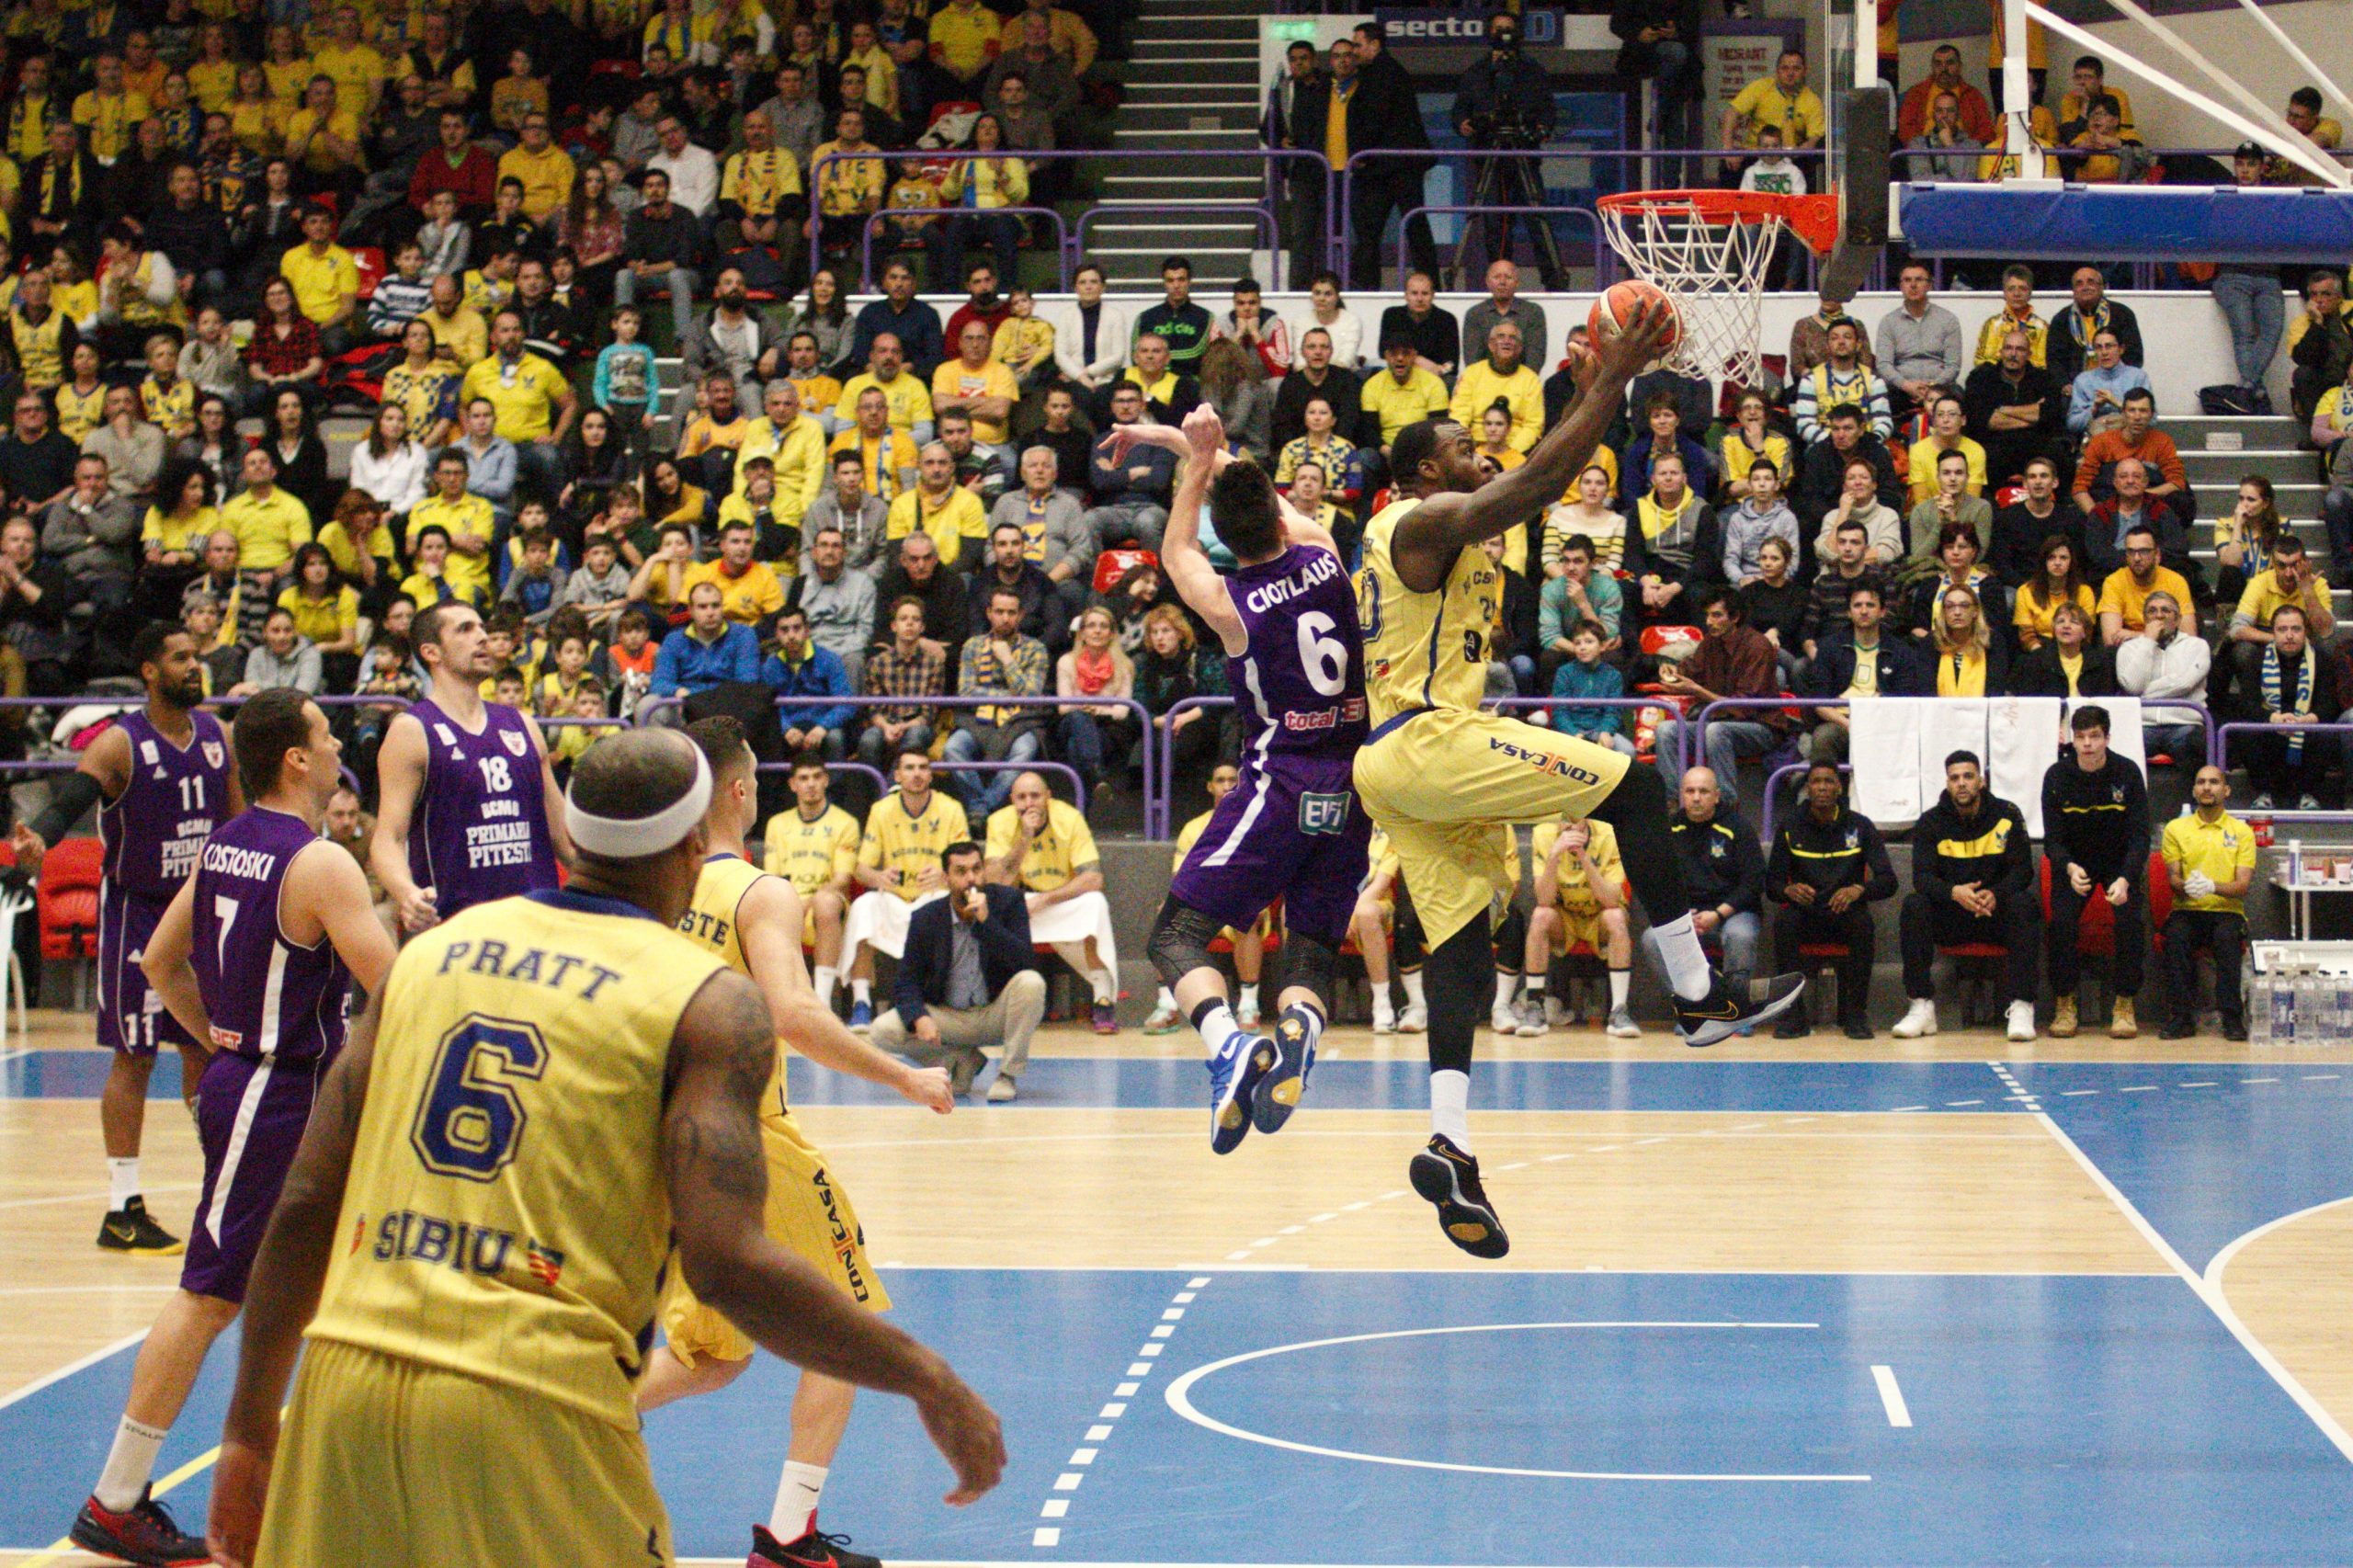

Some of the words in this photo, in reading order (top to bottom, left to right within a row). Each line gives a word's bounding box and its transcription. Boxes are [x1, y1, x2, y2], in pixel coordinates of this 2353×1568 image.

[1385, 17, 1483, 37] secto
[1297, 610, 1349, 697] 6
[1285, 706, 1338, 731] total
[178, 775, 206, 812] 11
[477, 756, 513, 794] 18
[214, 894, 239, 979] 7
[437, 938, 621, 1002] PRATT
[124, 1013, 154, 1047] 11
[410, 1011, 550, 1184] 6
[373, 1209, 517, 1277] SIBIU
